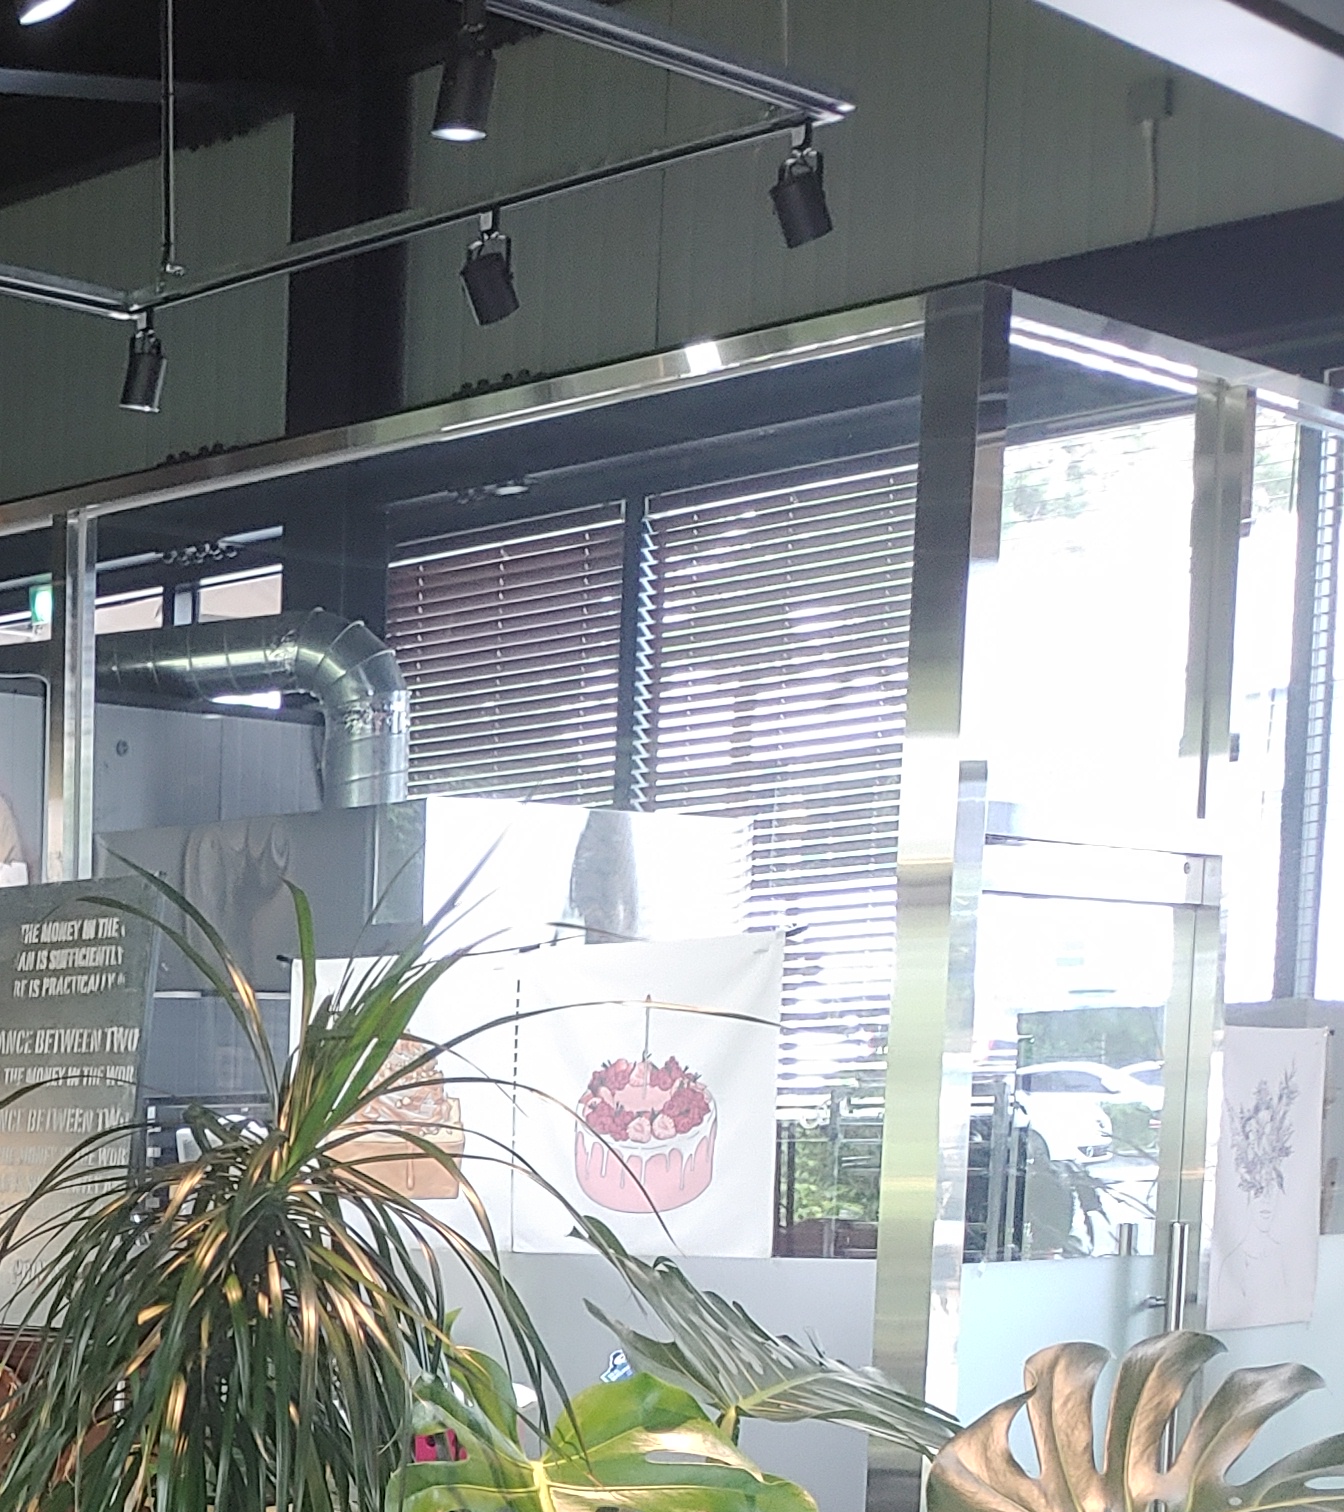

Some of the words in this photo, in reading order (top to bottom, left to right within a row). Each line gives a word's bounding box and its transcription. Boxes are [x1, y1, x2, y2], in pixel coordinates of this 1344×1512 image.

[40, 920, 82, 944] MONEY
[97, 917, 120, 938] THE
[36, 950, 48, 970] IS
[28, 977, 40, 998] IS
[41, 973, 116, 997] PRACTICALLY
[34, 1028, 102, 1055] BETWEEN
[105, 1026, 141, 1053] TWO
[26, 1106, 94, 1133] BETWEEN
